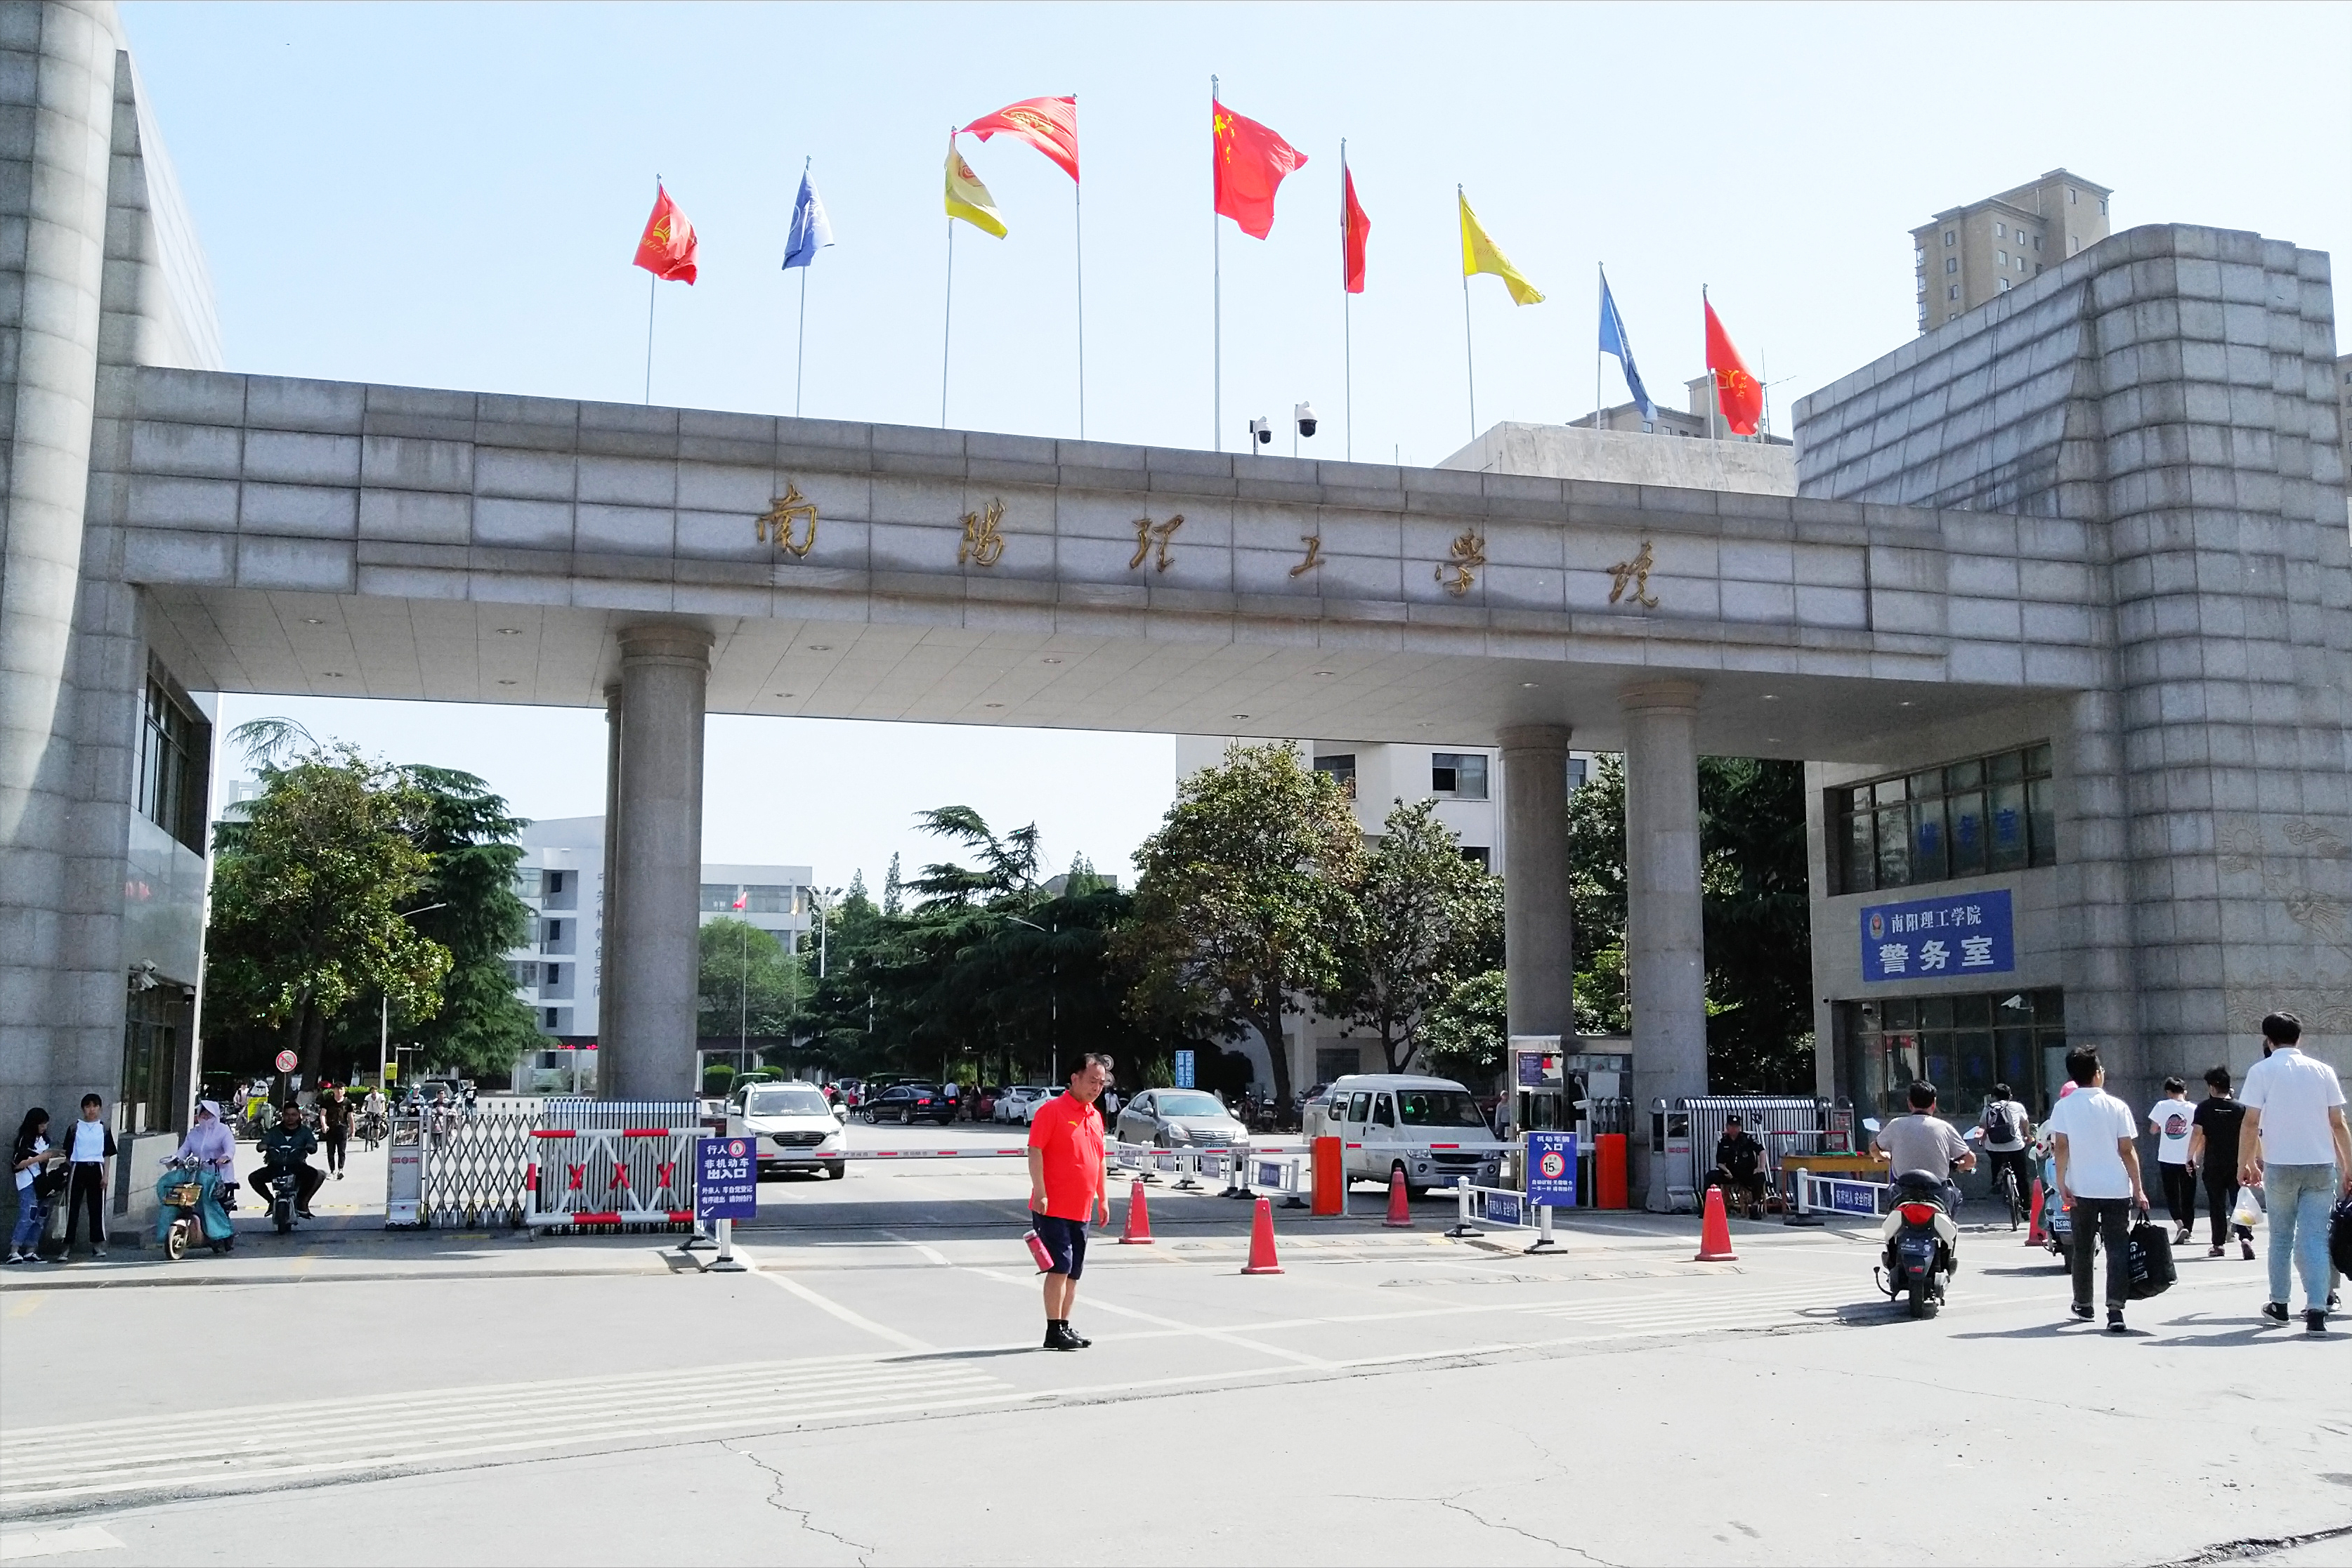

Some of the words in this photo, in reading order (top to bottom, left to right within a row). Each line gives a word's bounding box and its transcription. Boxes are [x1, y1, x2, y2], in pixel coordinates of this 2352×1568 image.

[1891, 905, 1982, 933] 南阳理工学院
[1879, 935, 1994, 974] 警务室
[707, 1145, 728, 1155] 行人
[705, 1158, 749, 1168] 非机动车
[1544, 1163, 1555, 1172] 15
[707, 1168, 746, 1180] 出入口
